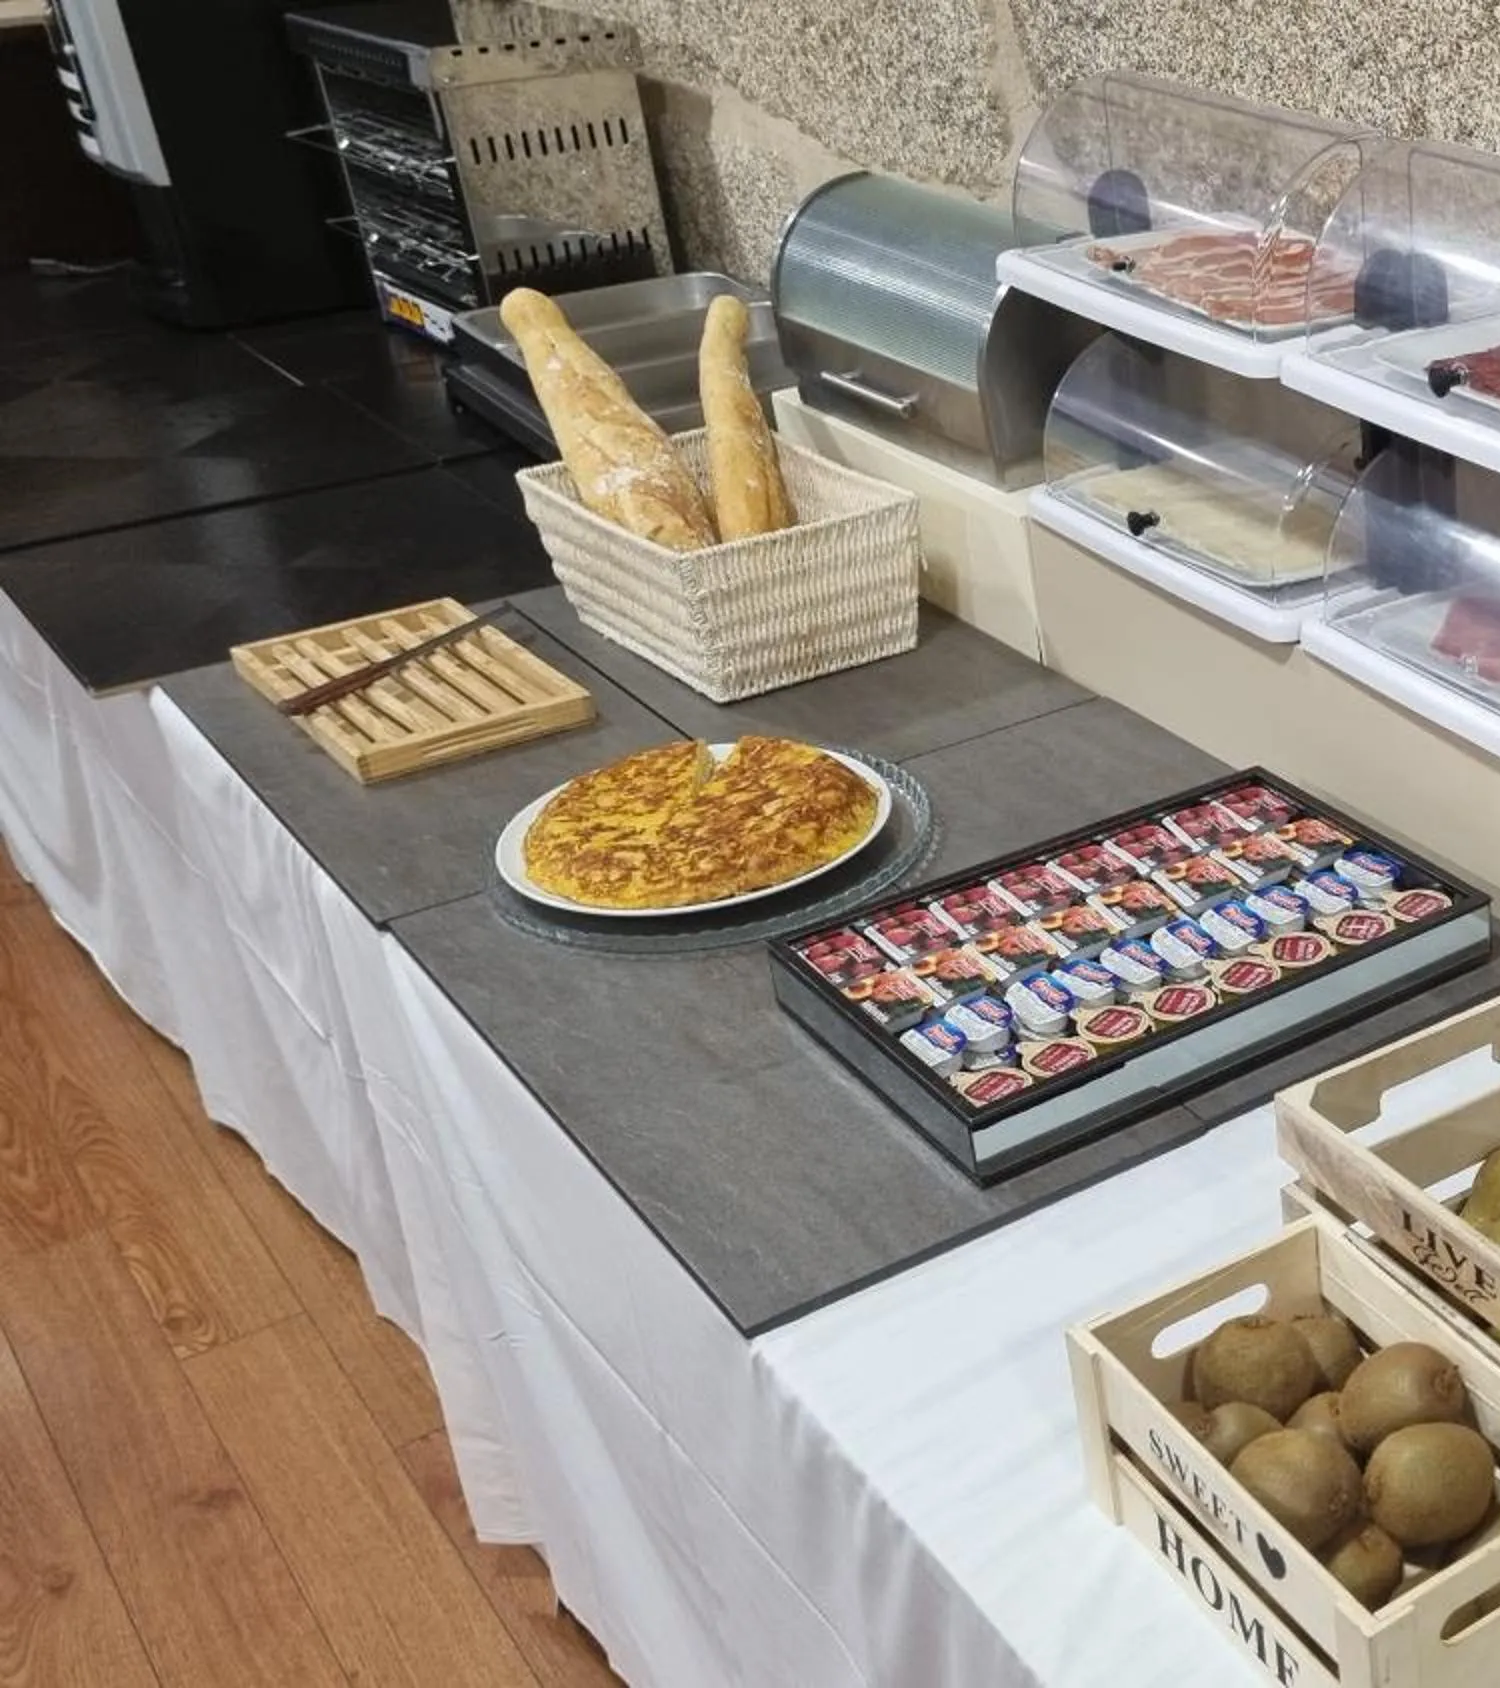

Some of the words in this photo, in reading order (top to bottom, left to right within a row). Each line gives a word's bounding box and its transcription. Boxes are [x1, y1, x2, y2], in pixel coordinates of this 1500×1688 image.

[1402, 1209, 1498, 1299] LIVE
[1149, 1428, 1249, 1544] SWEET
[1156, 1513, 1300, 1688] HOME
